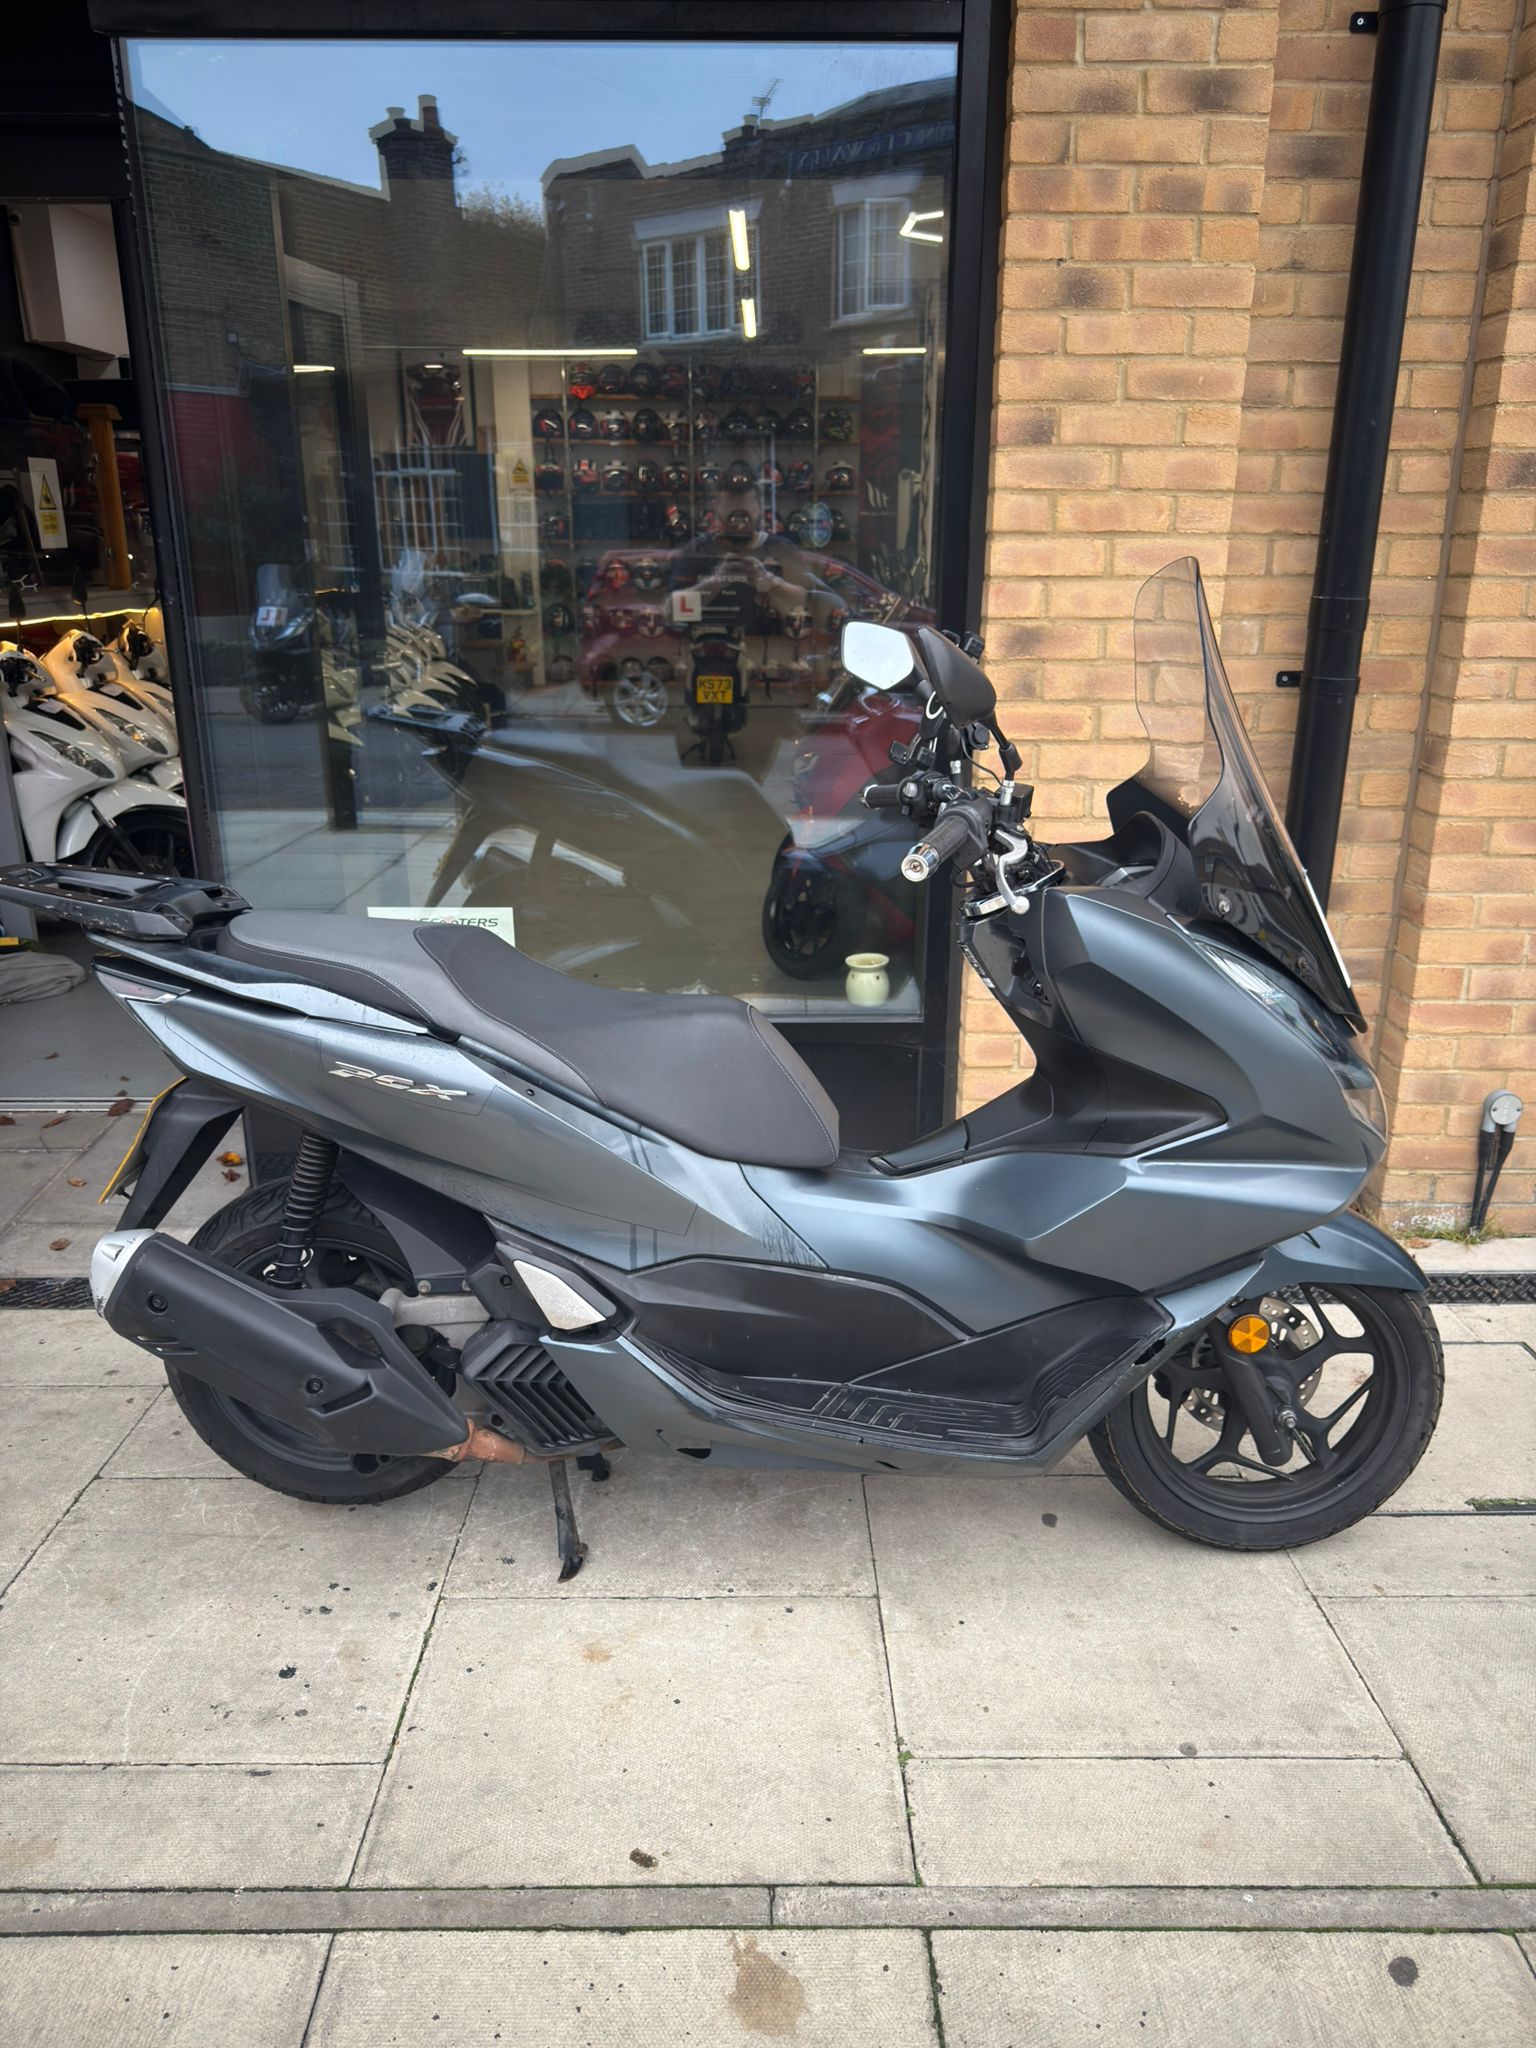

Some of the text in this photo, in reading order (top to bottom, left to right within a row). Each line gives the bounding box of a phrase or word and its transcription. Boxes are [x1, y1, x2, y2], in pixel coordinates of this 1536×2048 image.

[680, 595, 694, 614] L
[699, 678, 731, 689] KS73
[703, 690, 727, 701] VXT
[328, 1061, 467, 1102] PCX
